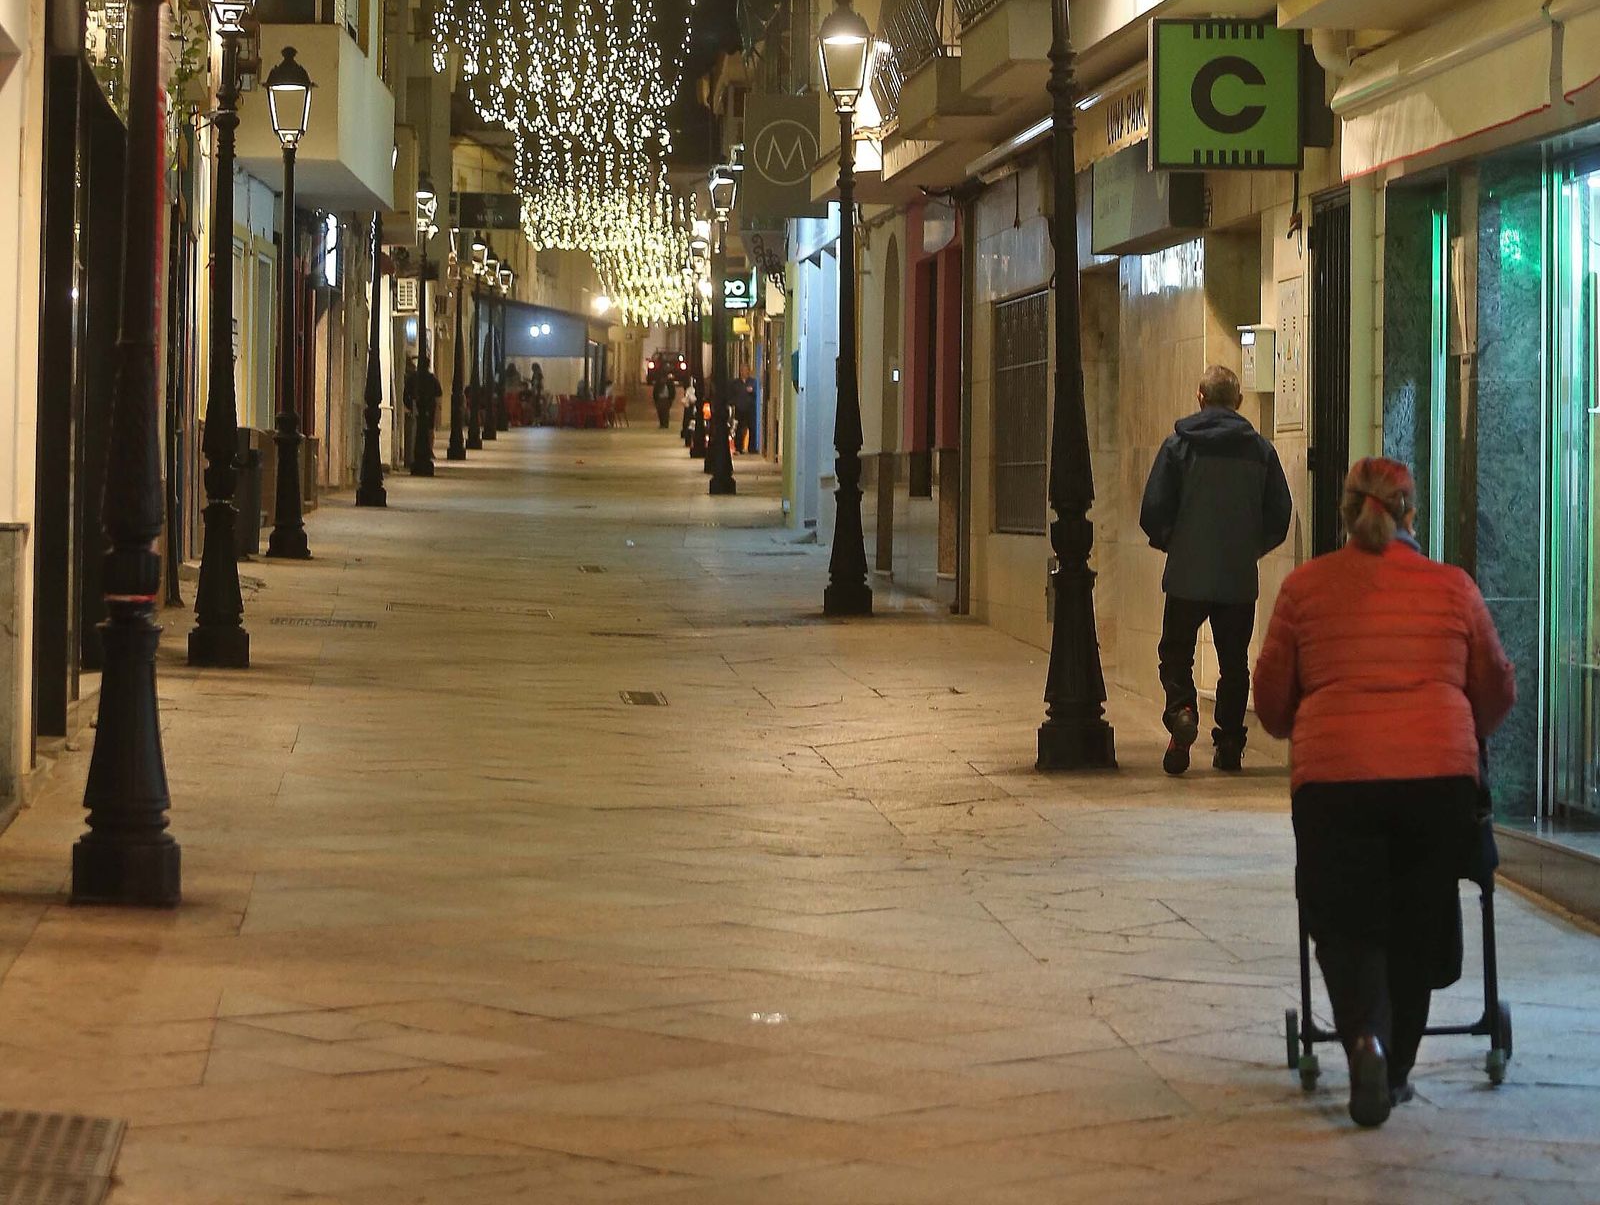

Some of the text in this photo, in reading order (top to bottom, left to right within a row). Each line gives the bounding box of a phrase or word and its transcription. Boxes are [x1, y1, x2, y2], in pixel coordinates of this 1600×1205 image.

[1126, 86, 1147, 135] PARK
[1190, 55, 1267, 135] C
[765, 134, 807, 171] M
